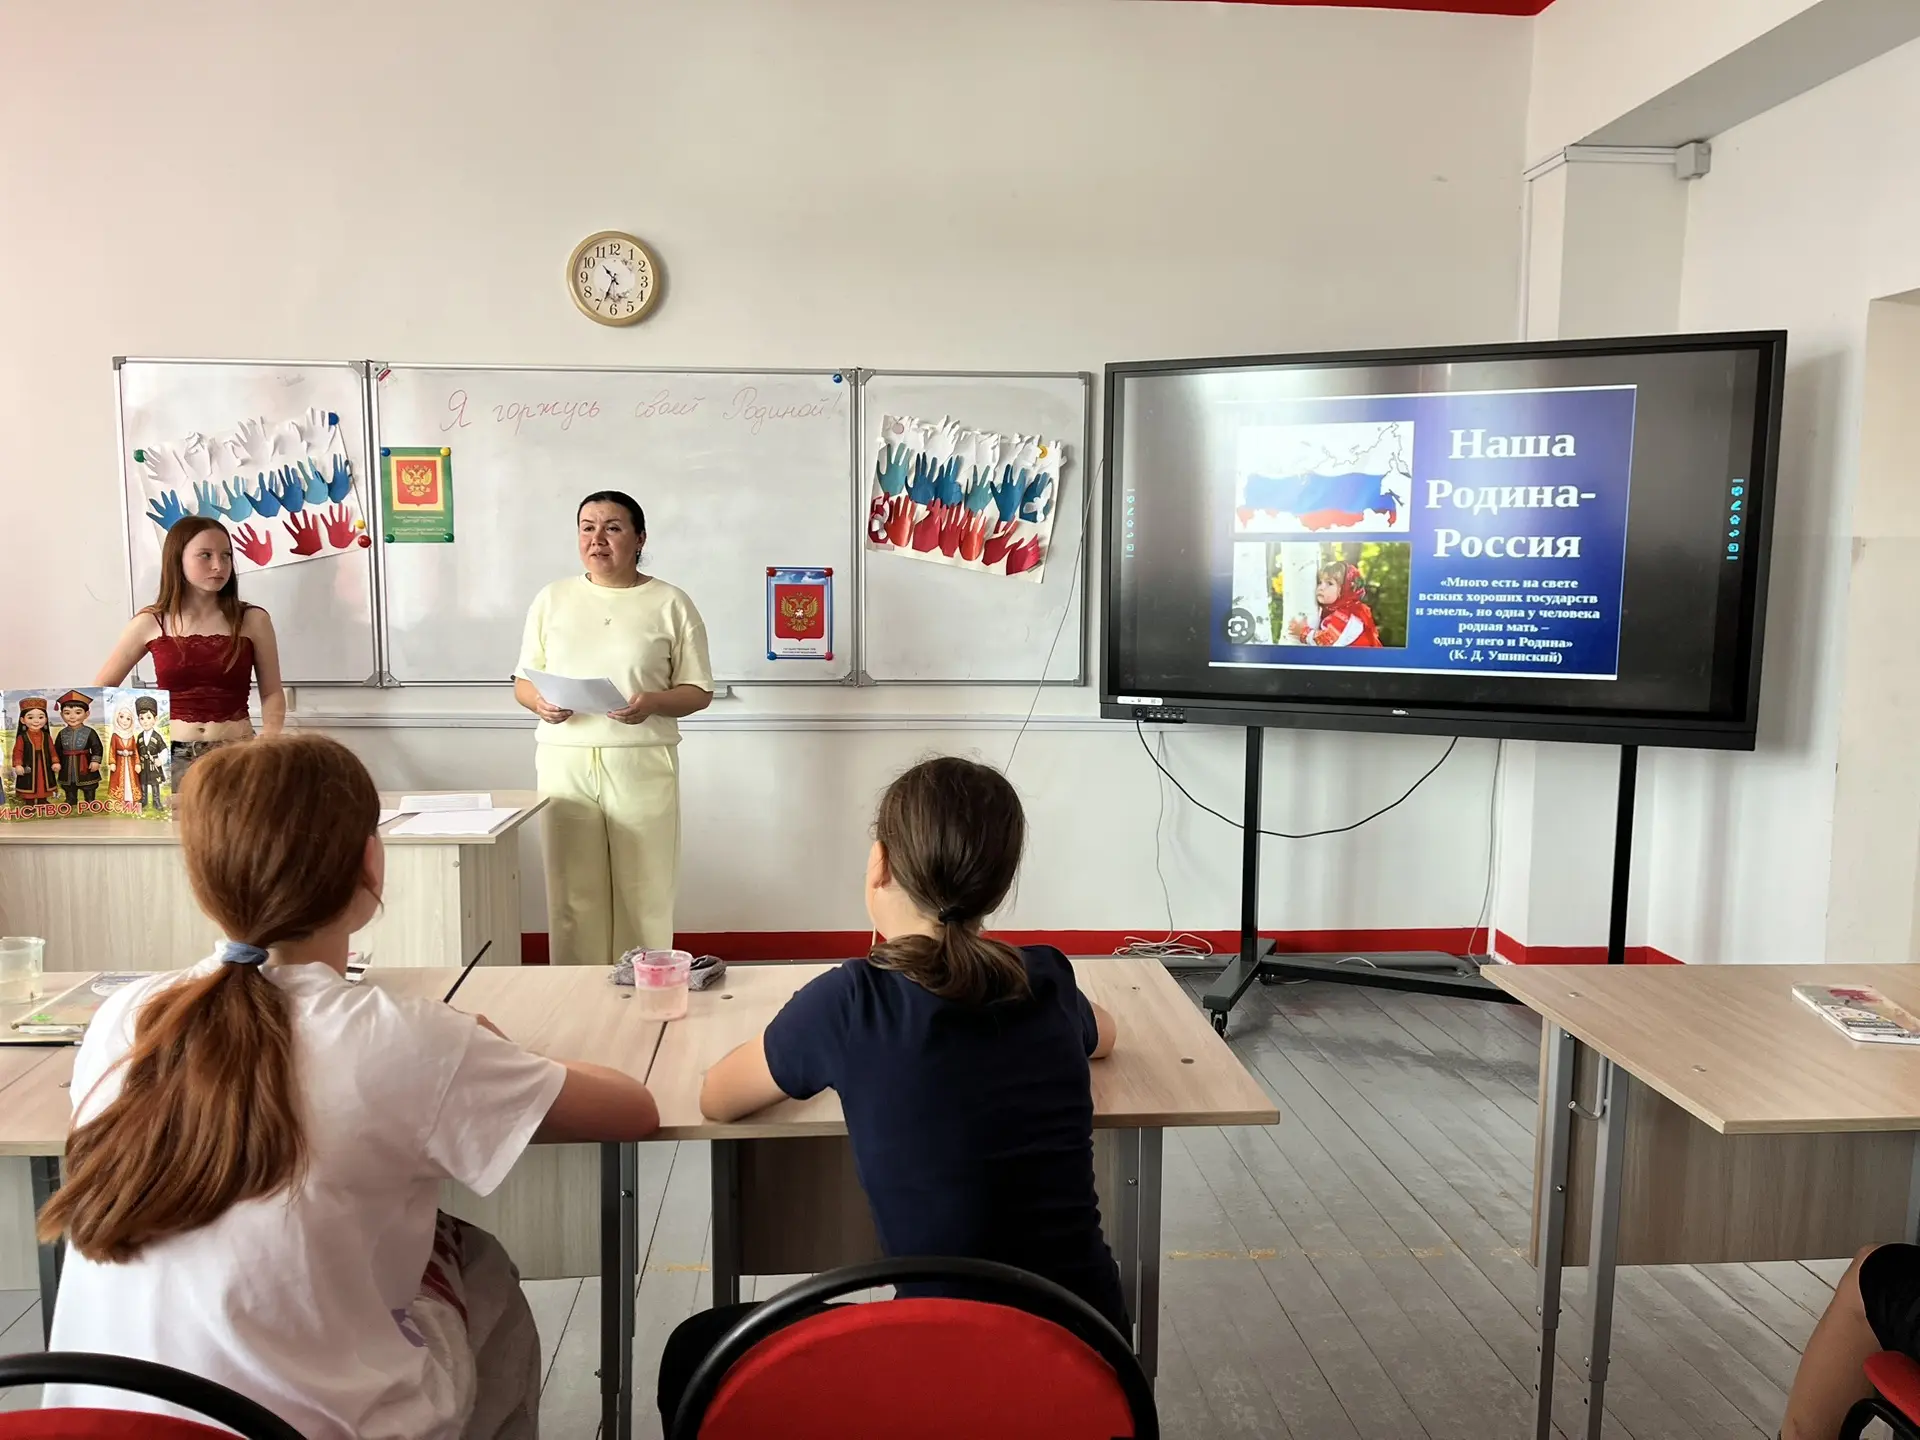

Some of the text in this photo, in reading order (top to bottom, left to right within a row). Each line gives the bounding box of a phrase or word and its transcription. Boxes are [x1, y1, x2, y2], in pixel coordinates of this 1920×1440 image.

[595, 246, 606, 258] 11
[608, 243, 621, 256] 12
[628, 248, 634, 260] 1
[584, 257, 596, 269] 10
[638, 260, 646, 273] 2
[580, 271, 589, 284] 9
[640, 275, 648, 288] 3
[584, 286, 592, 298] 8
[637, 290, 644, 302] 4
[594, 298, 603, 311] 7
[609, 303, 618, 316] 6
[626, 301, 634, 313] 5
[440, 386, 843, 436] Я горжусь своей Родиной!
[1448, 428, 1577, 459] Наша
[1425, 479, 1597, 516] Родина-
[1433, 528, 1582, 558] Россия
[1440, 577, 1579, 589] «Много есть на свете
[1419, 593, 1598, 605] всяких хороших государств
[1415, 607, 1600, 620] и земель, но одна у человека
[1458, 622, 1503, 633] родная
[1506, 623, 1538, 632] мать
[1433, 637, 1574, 649] одна у него и Родина»
[1449, 649, 1563, 664] (К. Д. Ушинский)
[77, 799, 142, 816] РОССИИ
